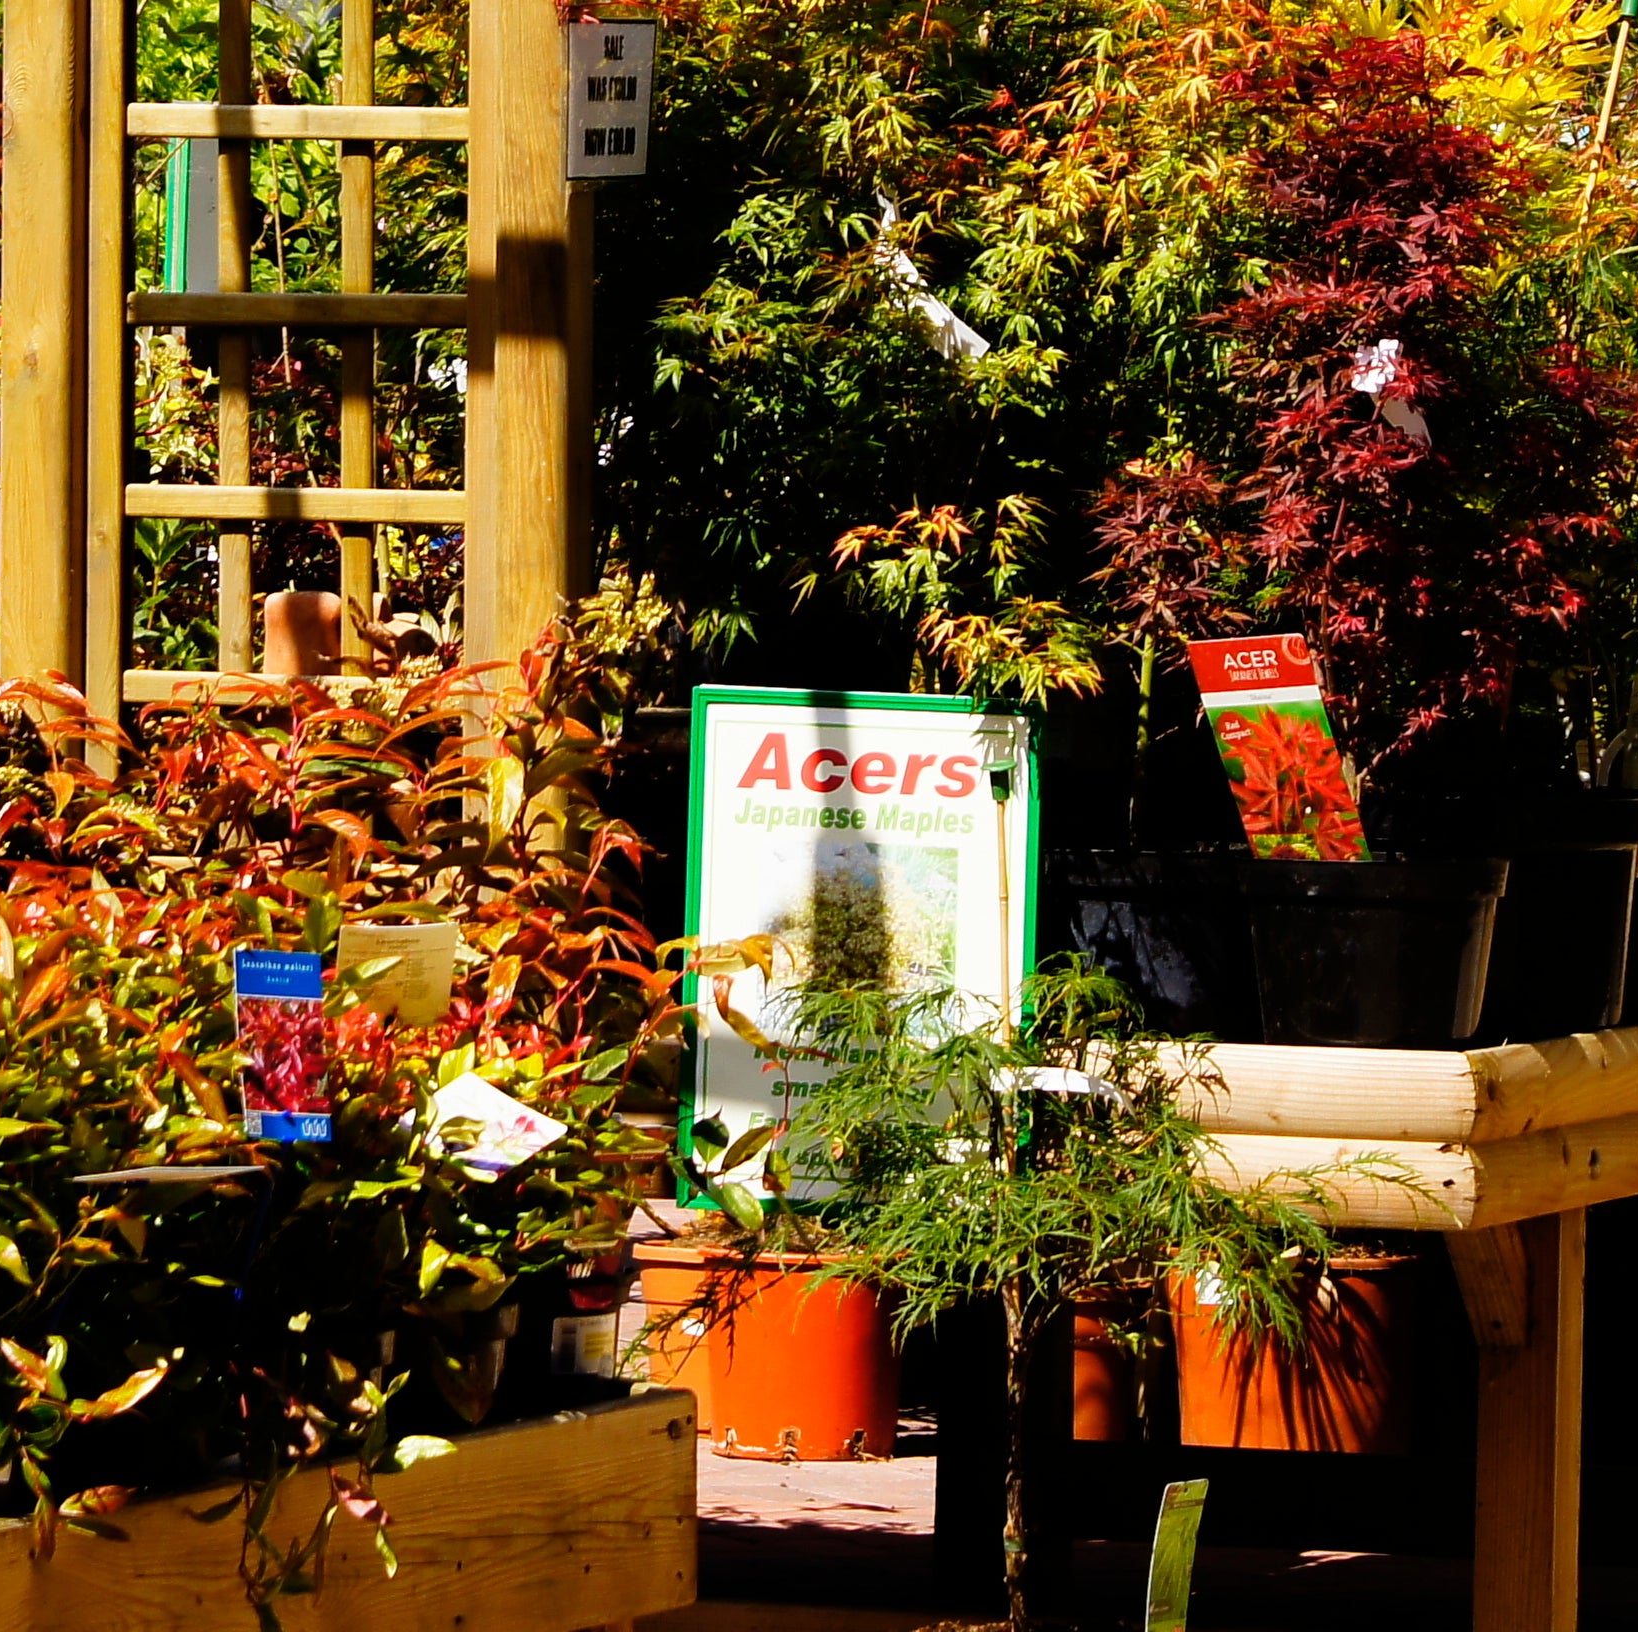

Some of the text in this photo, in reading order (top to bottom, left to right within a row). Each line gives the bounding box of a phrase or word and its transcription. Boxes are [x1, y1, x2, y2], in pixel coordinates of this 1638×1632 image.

[604, 35, 624, 60] SALE
[1224, 649, 1278, 669] ACER
[1220, 727, 1252, 741] Compact
[1225, 721, 1240, 731] Red
[736, 732, 979, 798] Acers
[735, 798, 976, 838] Japanese Maples
